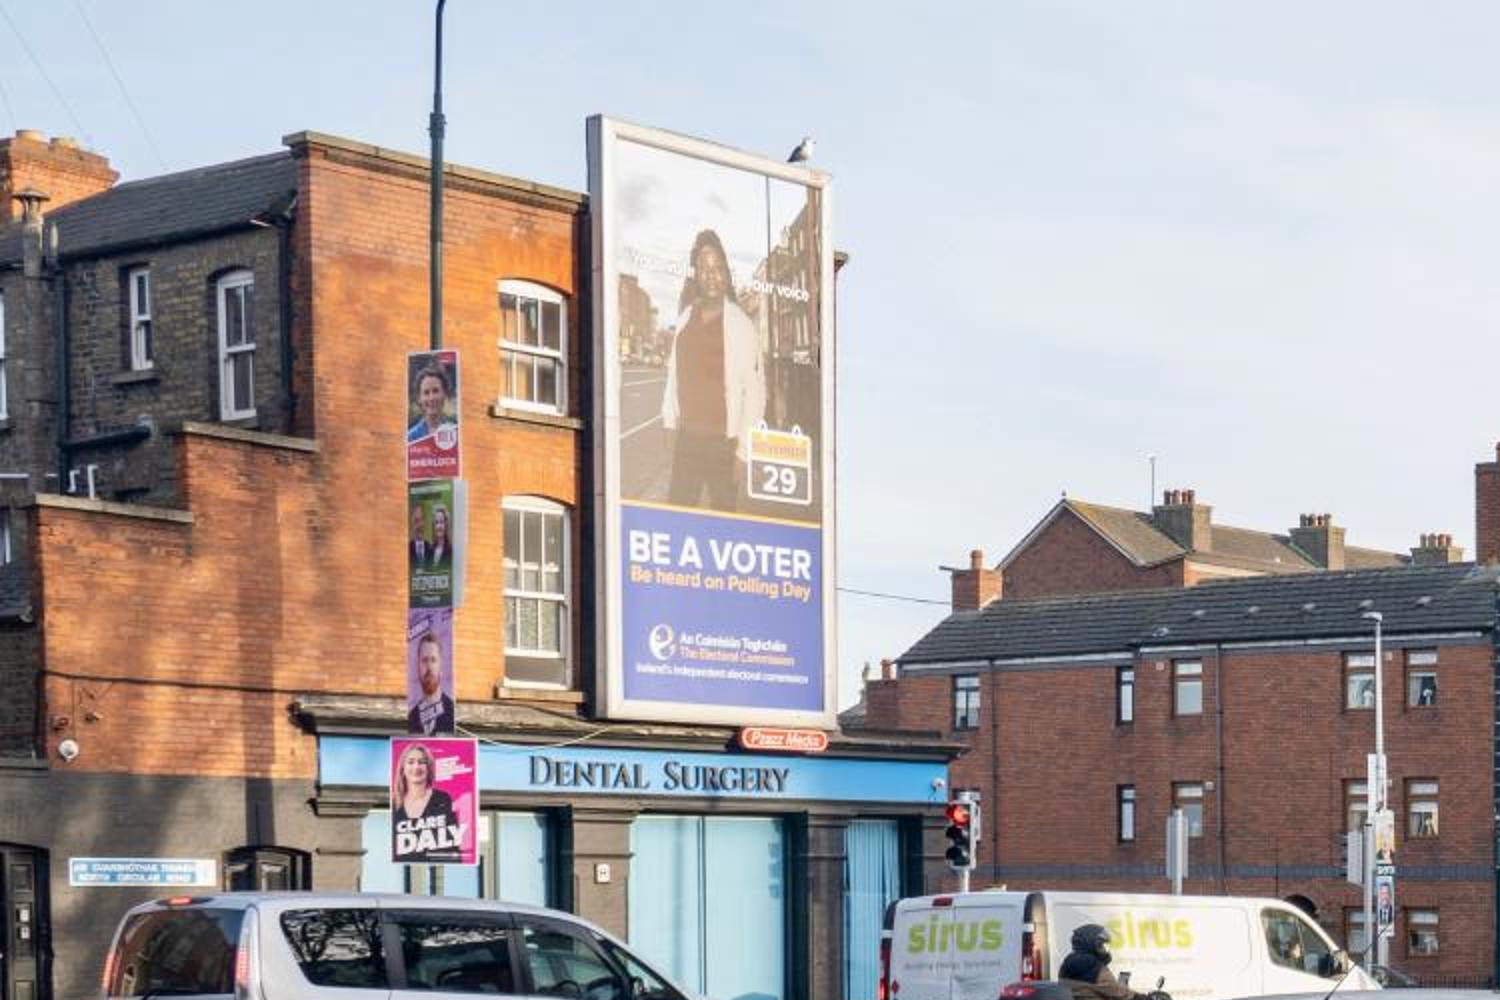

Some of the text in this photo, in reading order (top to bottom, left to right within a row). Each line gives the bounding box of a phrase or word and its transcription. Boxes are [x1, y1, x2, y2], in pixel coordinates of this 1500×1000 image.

[763, 465, 797, 495] 29
[629, 530, 812, 581] BE A VOTER
[631, 565, 811, 602] Be heard on Polling Day
[529, 755, 790, 793] DENTAL SURGERY
[396, 814, 447, 833] CLARE
[396, 823, 468, 855] DALY
[907, 913, 1003, 953] sirus
[1105, 911, 1194, 950] sirus
